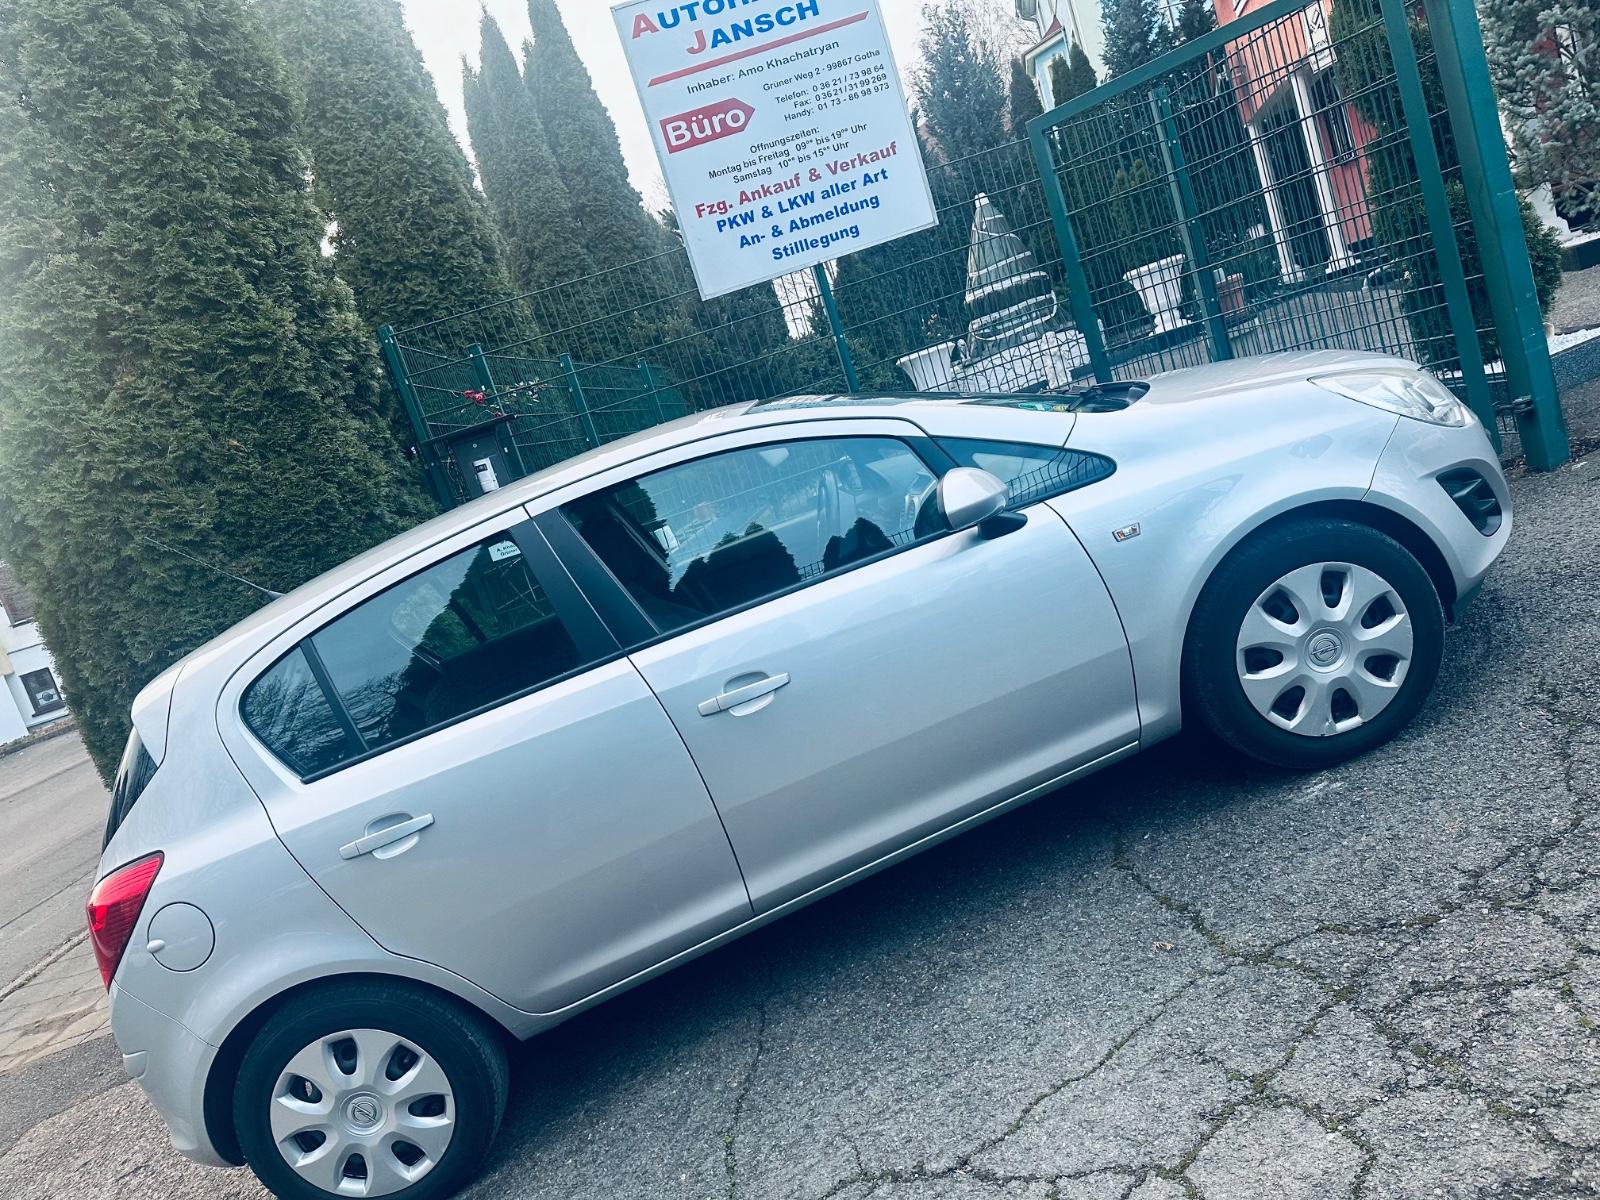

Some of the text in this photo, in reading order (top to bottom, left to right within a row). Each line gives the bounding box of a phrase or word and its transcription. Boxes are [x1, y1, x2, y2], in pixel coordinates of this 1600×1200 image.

[631, 0, 758, 39] AUTO
[686, 0, 819, 54] JANSCH
[686, 41, 839, 94] Inhaber: Amo Khachatryan
[793, 71, 813, 81] Weg
[814, 67, 820, 75] 2
[826, 56, 851, 71] 99867
[854, 49, 880, 61] Gotha
[775, 89, 808, 103] Telefon:
[783, 107, 814, 121] Handy:
[873, 82, 889, 92] 973
[793, 98, 811, 108] Fax:
[665, 108, 746, 146] Büro
[708, 163, 741, 179] Montag
[742, 159, 756, 168] bis
[757, 148, 790, 163] Freitag
[814, 136, 830, 145] bis
[850, 123, 866, 133] Uhr
[732, 166, 771, 183] Samstag
[797, 153, 811, 163] bis
[832, 141, 848, 151] Uhr
[695, 140, 896, 218] Fzg. Ankauf & Verkauf
[716, 167, 888, 232] PKW & LKW aller Art
[739, 195, 879, 248] An- & Abmeldung
[771, 224, 859, 260] Stilllegung
